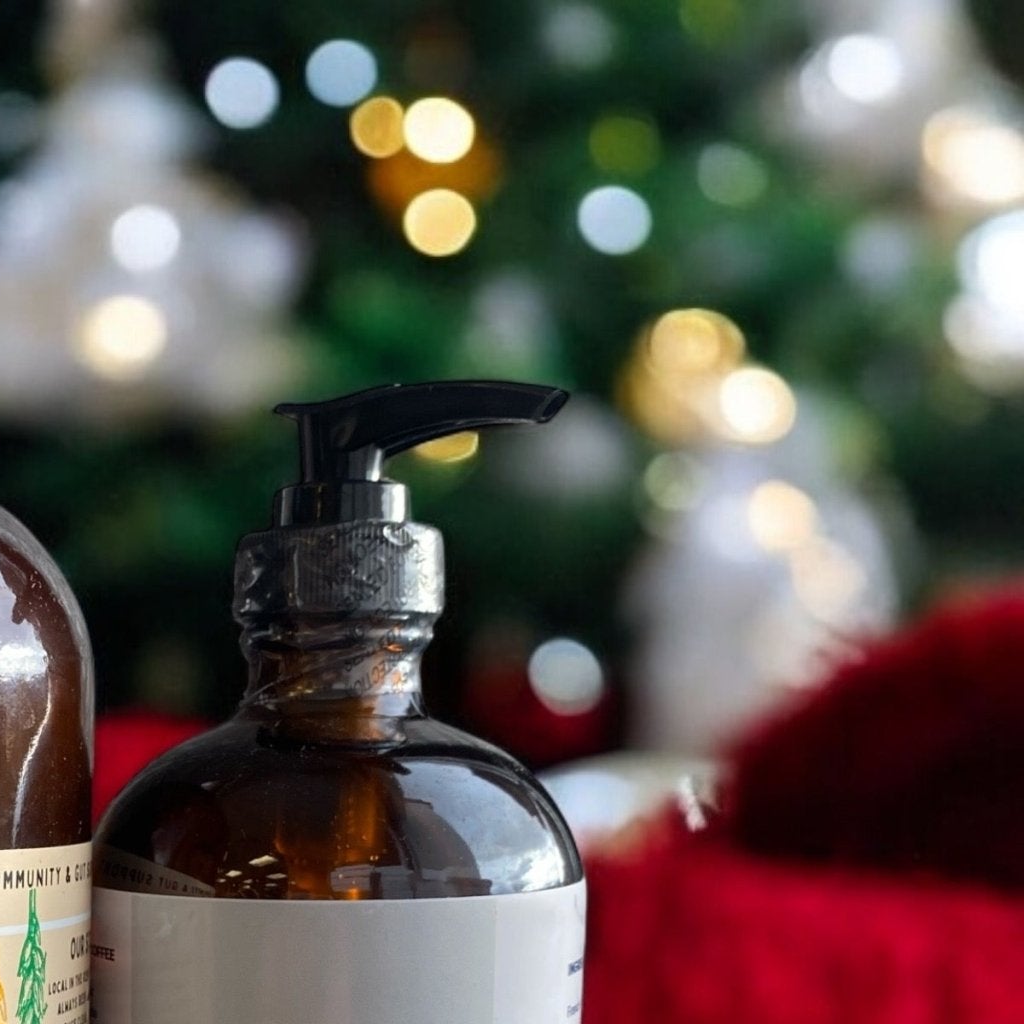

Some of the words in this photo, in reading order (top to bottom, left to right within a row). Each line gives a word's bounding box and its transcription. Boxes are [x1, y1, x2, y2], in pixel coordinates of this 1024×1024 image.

[66, 866, 71, 883] &
[48, 977, 67, 995] LOCAL
[57, 996, 77, 1015] ALWAYS
